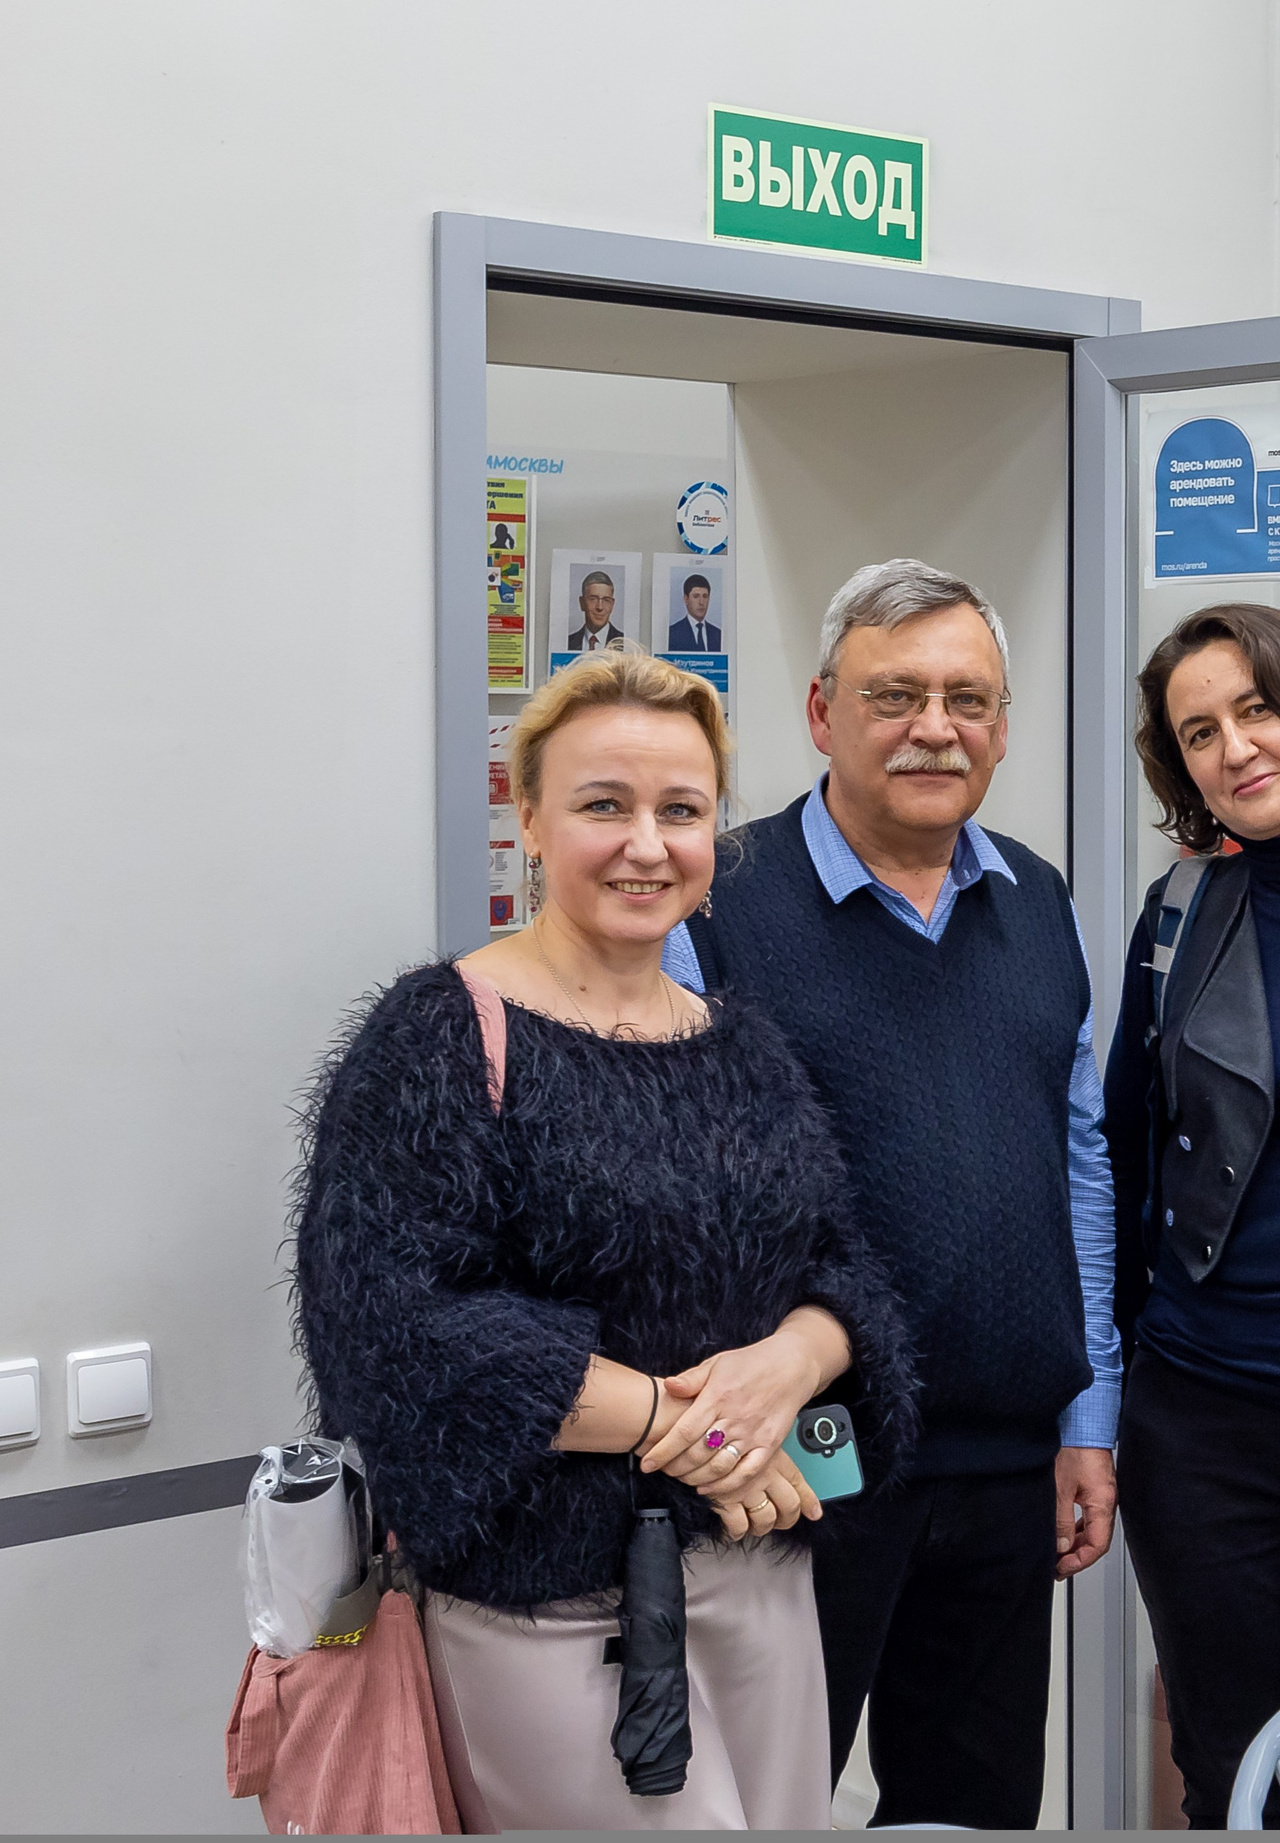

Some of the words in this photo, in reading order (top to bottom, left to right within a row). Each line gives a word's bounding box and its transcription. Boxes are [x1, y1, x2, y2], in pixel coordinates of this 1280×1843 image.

[722, 134, 915, 240] ВЫХОД
[1170, 460, 1203, 473] Здесь
[1204, 458, 1243, 470] можно
[1169, 476, 1236, 493] арендовать
[1170, 494, 1236, 507] помещение
[1268, 527, 1274, 536] С
[1161, 561, 1208, 571] mos.ru/arenda
